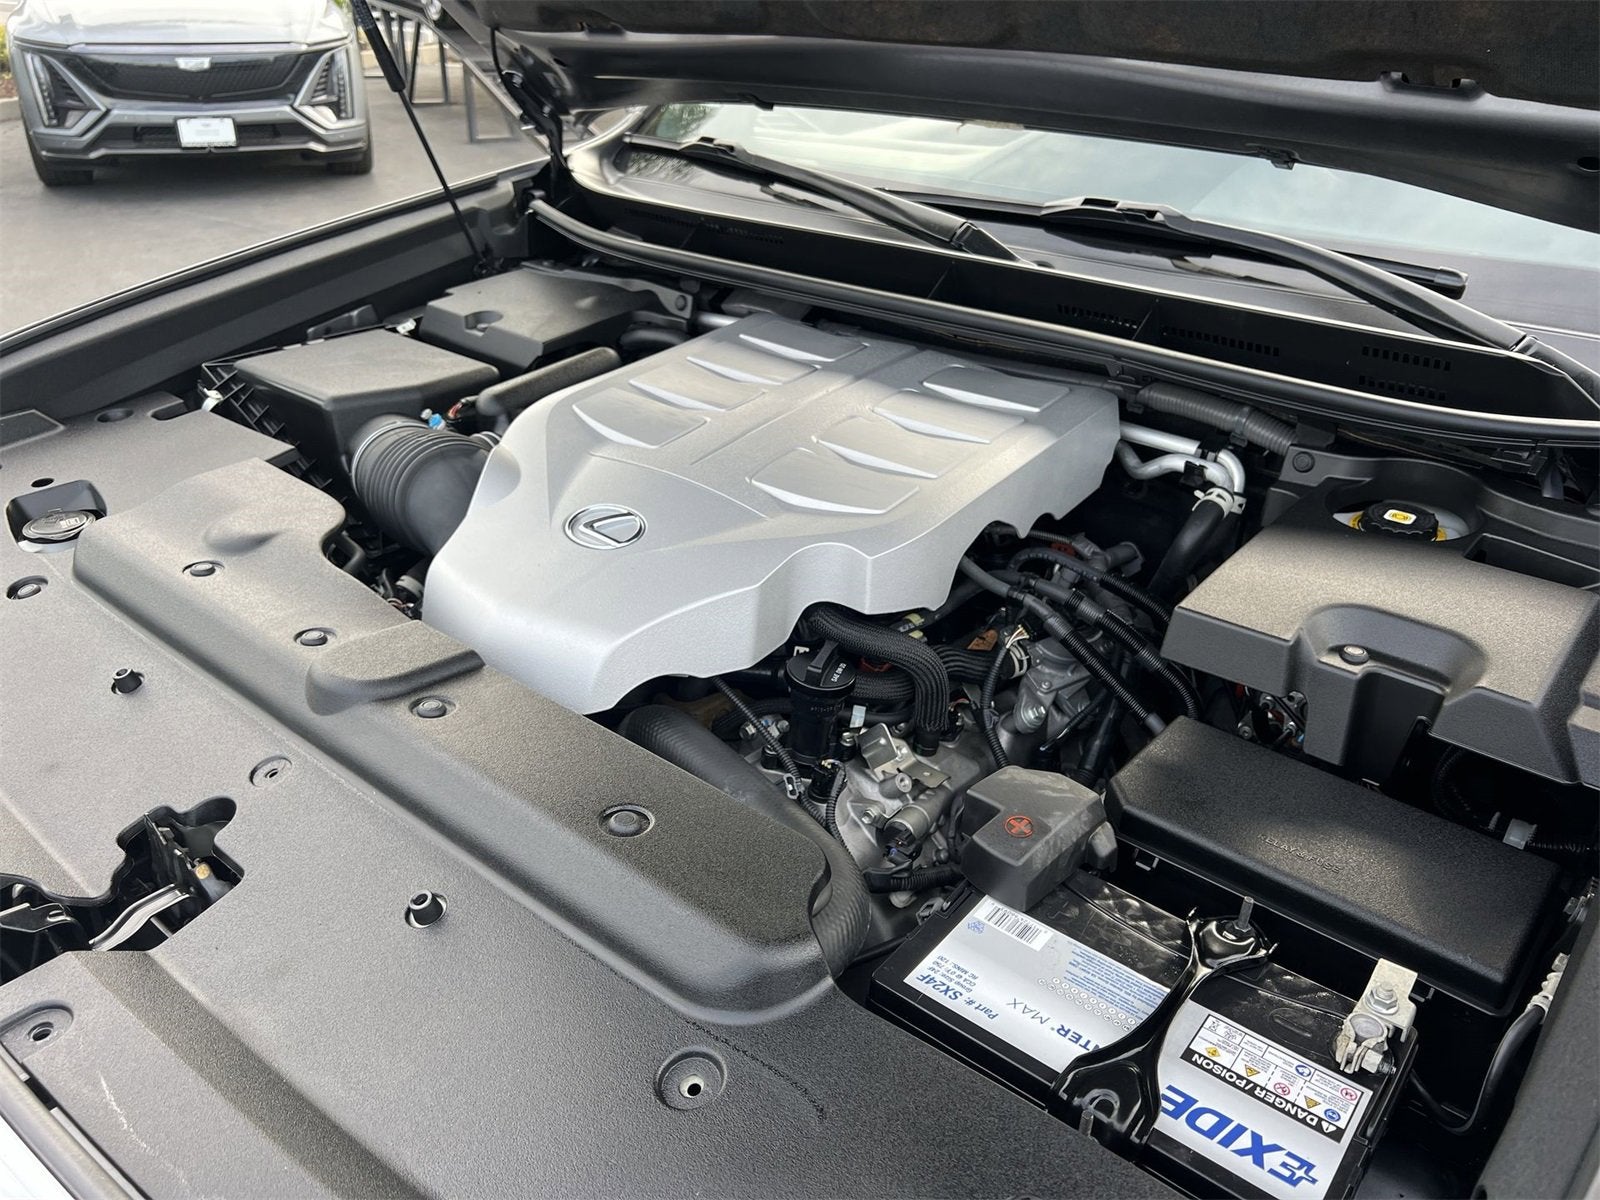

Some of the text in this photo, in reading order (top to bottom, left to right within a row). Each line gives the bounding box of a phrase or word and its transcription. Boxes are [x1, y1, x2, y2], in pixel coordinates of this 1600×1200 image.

[916, 974, 963, 1001] SX24F
[975, 1003, 999, 1020] Part
[1006, 998, 1051, 1025] MAX
[1255, 1086, 1318, 1127] DANGER
[1161, 1084, 1319, 1188] EXIDE
